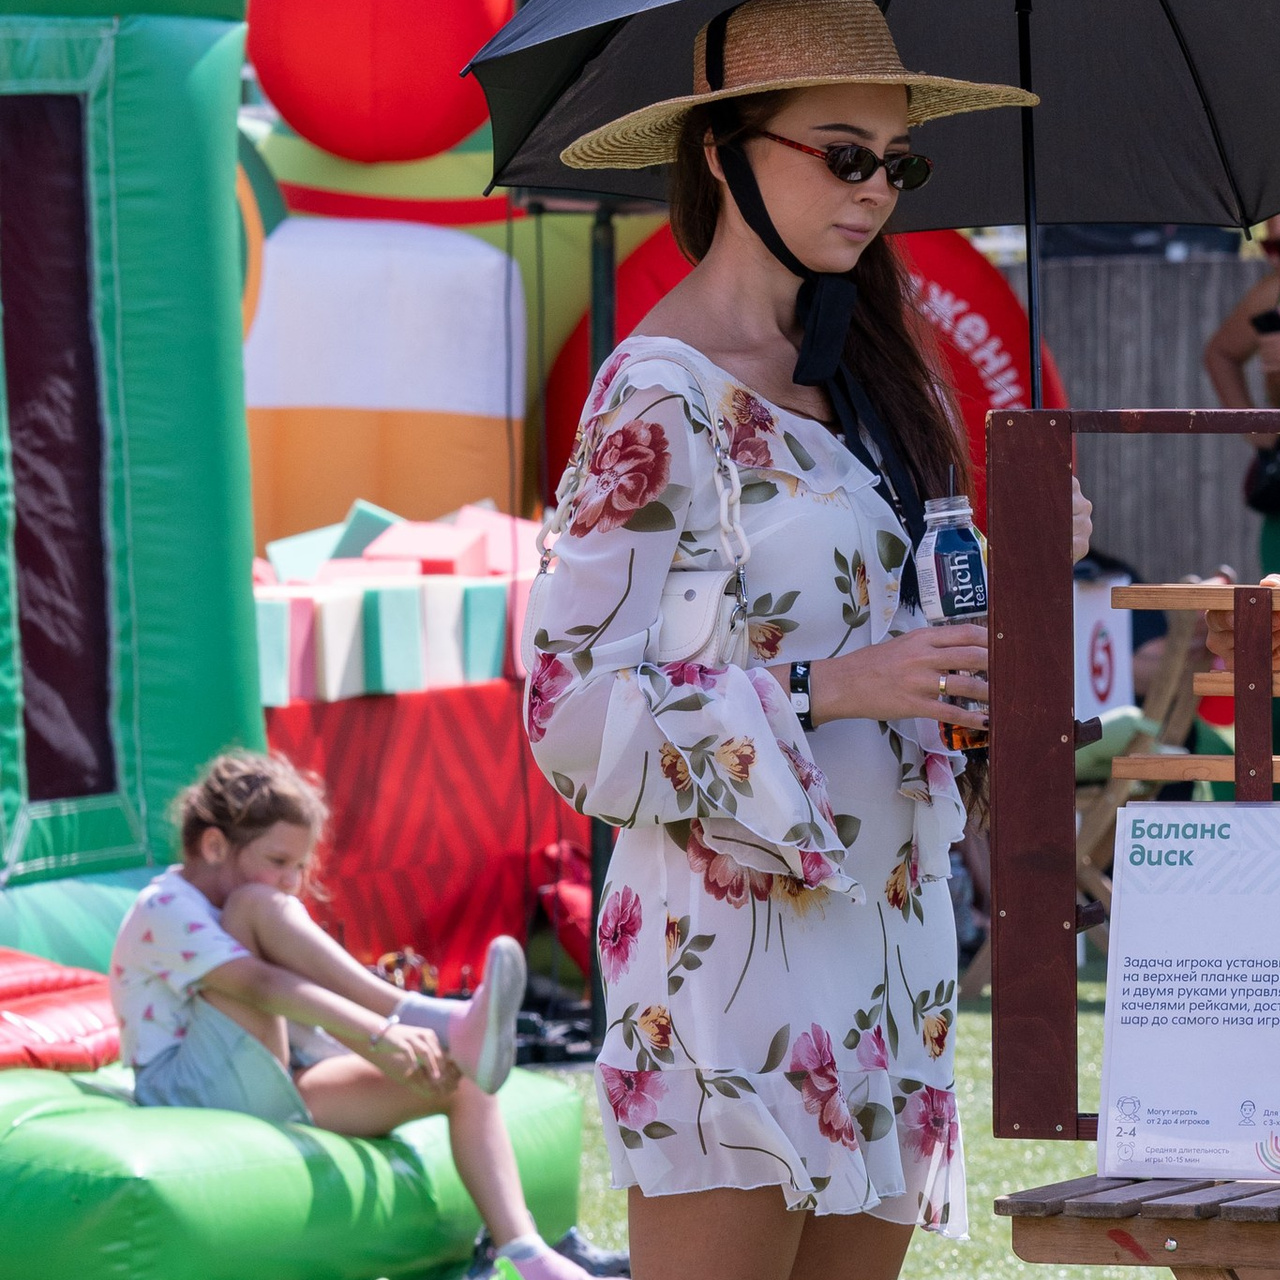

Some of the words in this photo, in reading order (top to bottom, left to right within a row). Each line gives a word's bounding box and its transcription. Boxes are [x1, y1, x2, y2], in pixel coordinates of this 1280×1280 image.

[902, 275, 1027, 408] жени
[950, 554, 976, 609] Rich
[975, 584, 986, 607] tea
[1130, 818, 1231, 840] Баланс
[1128, 843, 1195, 866] диск
[1123, 956, 1173, 969] Задача
[1176, 958, 1222, 970] игрока
[1123, 973, 1139, 982] на
[1143, 971, 1197, 984] верхней
[1200, 973, 1248, 982] планке
[1122, 988, 1130, 996] и
[1133, 987, 1174, 999] двумя
[1177, 988, 1227, 999] руками
[1121, 1001, 1186, 1010] качелями
[1189, 999, 1251, 1013] рейками,
[1120, 1015, 1149, 1027] шар
[1151, 1016, 1169, 1027] до
[1171, 1016, 1219, 1025] самого
[1222, 1017, 1254, 1025] низа
[1147, 1108, 1171, 1117] Могут
[1171, 1109, 1198, 1117] играть
[1263, 1109, 1279, 1118] Для
[1162, 1119, 1173, 1127] до
[1179, 1119, 1210, 1127] игроков
[1115, 1126, 1137, 1138] 2-4
[1145, 1146, 1177, 1156] Средняя
[1177, 1147, 1230, 1156] длительность
[1144, 1157, 1164, 1165] игры
[1164, 1156, 1183, 1164] 10-15
